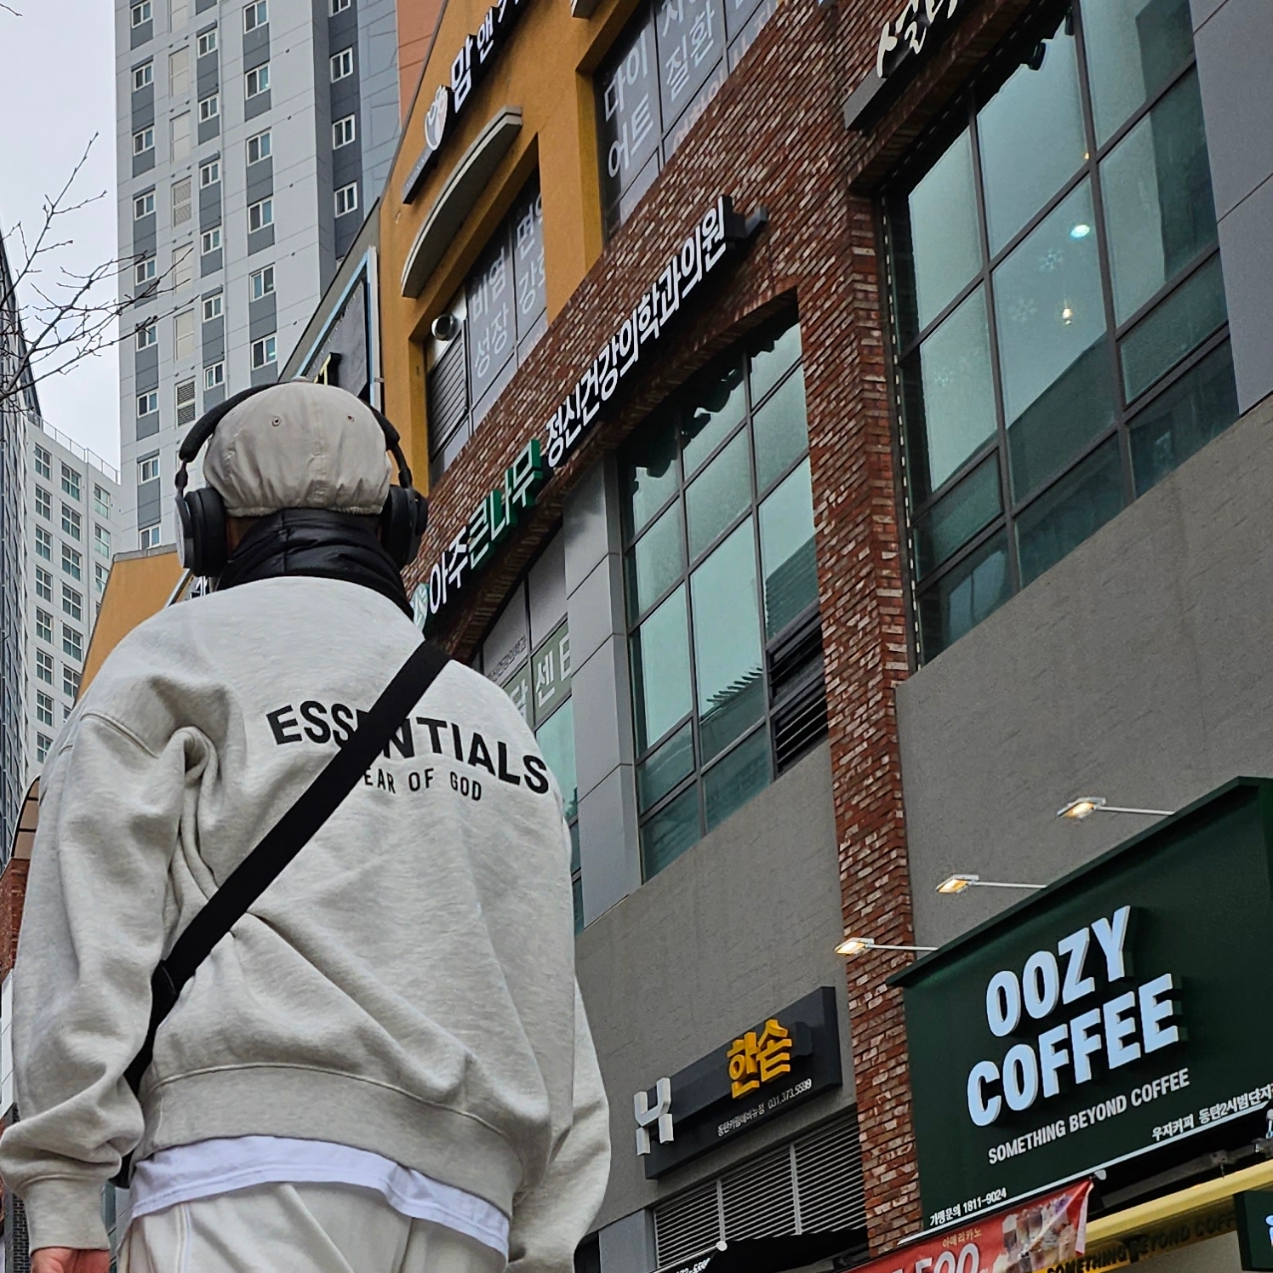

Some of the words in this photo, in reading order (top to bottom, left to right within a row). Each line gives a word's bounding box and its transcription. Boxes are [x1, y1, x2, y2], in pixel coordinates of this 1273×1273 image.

[430, 438, 538, 615] 아주큰나무
[545, 196, 728, 468] 정신건강의학과의원
[266, 700, 550, 794] ESSNTIALS
[363, 766, 396, 794] EAR
[408, 767, 435, 792] OF
[449, 770, 482, 801] GOD
[985, 904, 1131, 1038] OOZY
[727, 1018, 793, 1100] 한솥
[967, 973, 1180, 1127] COFFEE
[987, 1119, 1067, 1166] SOMETHING
[1068, 1094, 1128, 1132] BEYOND
[1130, 1066, 1191, 1108] COFFEE
[1151, 1113, 1195, 1142] 우지커피
[1198, 1082, 1273, 1124] 동탄2시범단지
[929, 1202, 962, 1228] 가맹문의
[962, 1187, 1008, 1213] 1811-9024
[941, 1227, 983, 1248] 아메리카노
